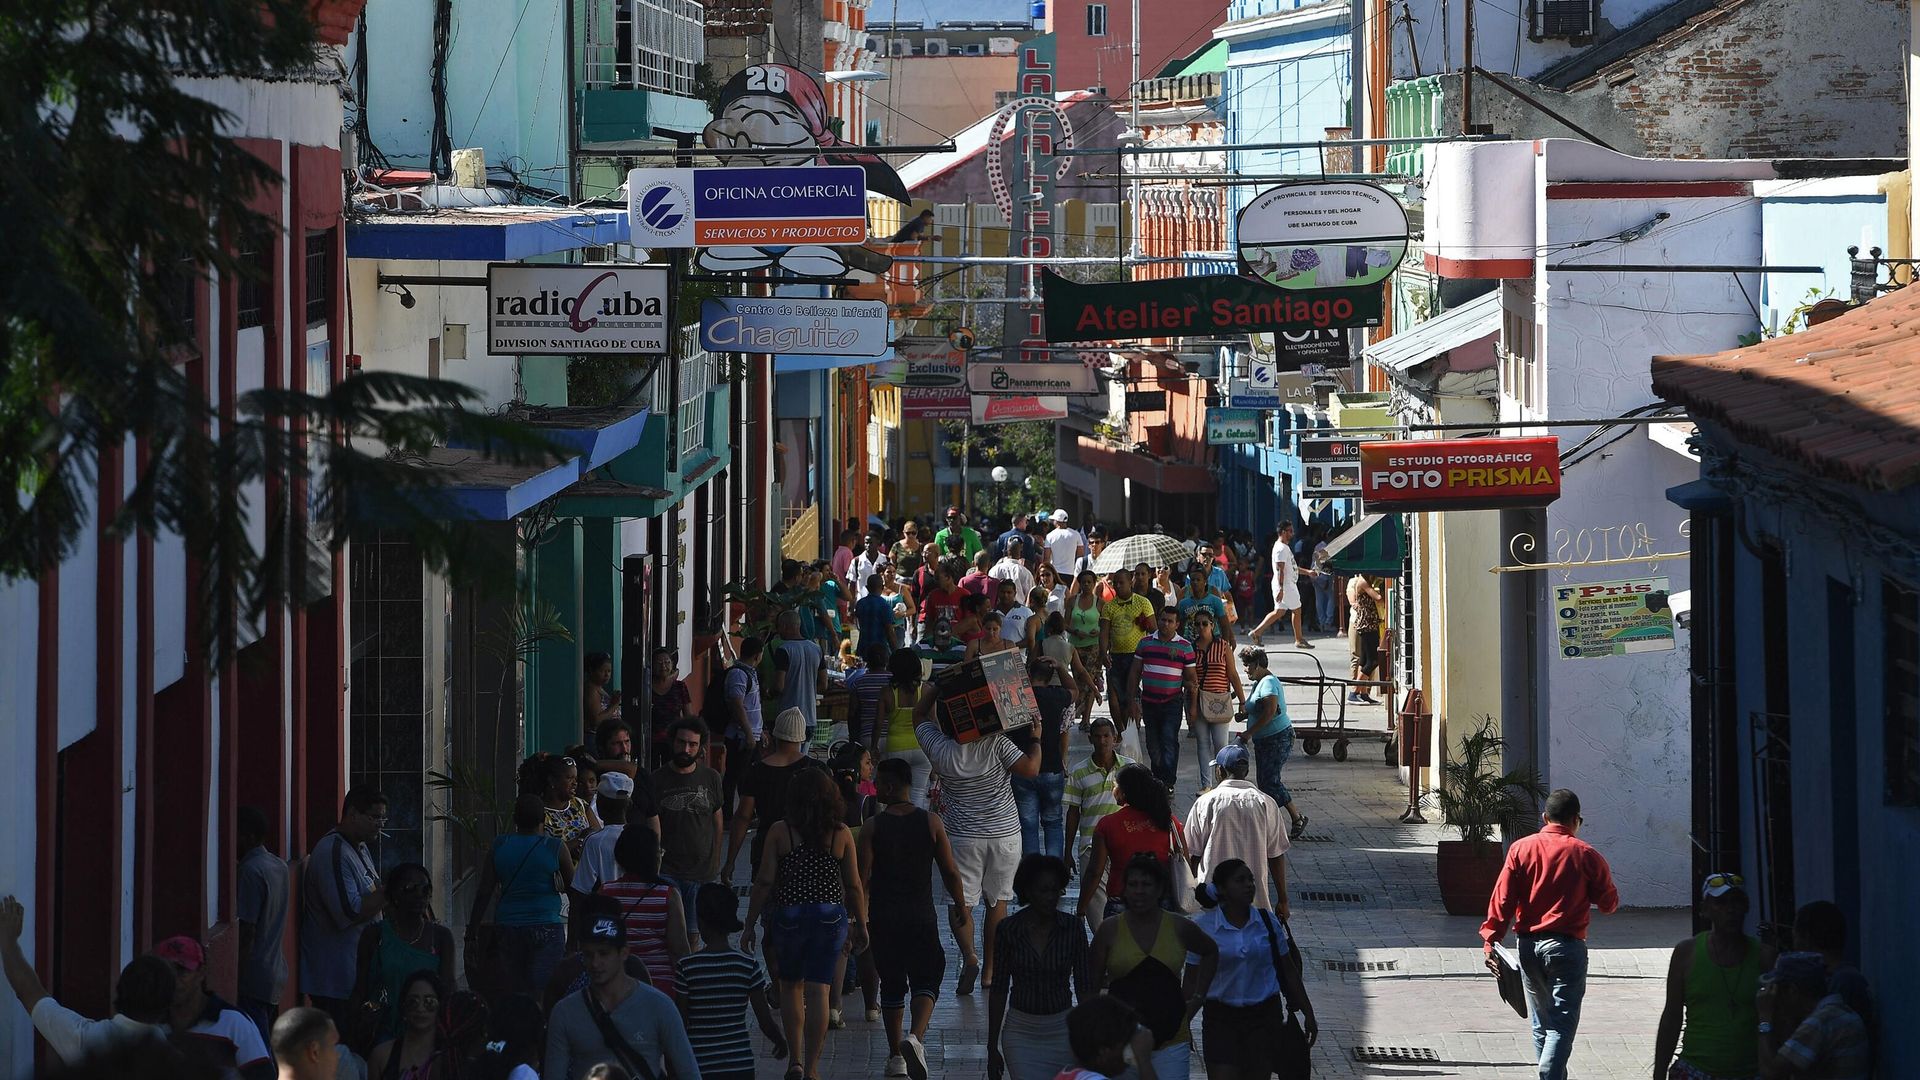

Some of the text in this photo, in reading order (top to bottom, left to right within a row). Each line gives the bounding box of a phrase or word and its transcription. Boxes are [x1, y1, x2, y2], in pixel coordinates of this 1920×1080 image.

[746, 66, 786, 94] 26
[704, 184, 857, 201] OFICINA COMERCIAL
[1260, 199, 1274, 210] EMP.
[1273, 191, 1308, 202] PROVINCIAL
[1351, 190, 1380, 205] TÉCNICOS
[703, 226, 859, 240] SERVICIOS Y PRODUCTOS
[736, 304, 882, 318] Centro de Belleza Infantil
[1074, 297, 1352, 331] Atelier Santiago
[707, 315, 859, 352] Chaguito
[495, 339, 661, 350] DIVISION SANTIAGO DE CUBA
[908, 362, 962, 373] Exclusivo
[1009, 378, 1071, 387] Panamericana
[1286, 388, 1301, 398] LA
[1388, 452, 1533, 467] ESTUDIO FOTOGRÁFICO
[1371, 466, 1554, 490] FOTO PRISMA
[1579, 583, 1652, 598] Pris
[597, 919, 614, 927] NIKE
